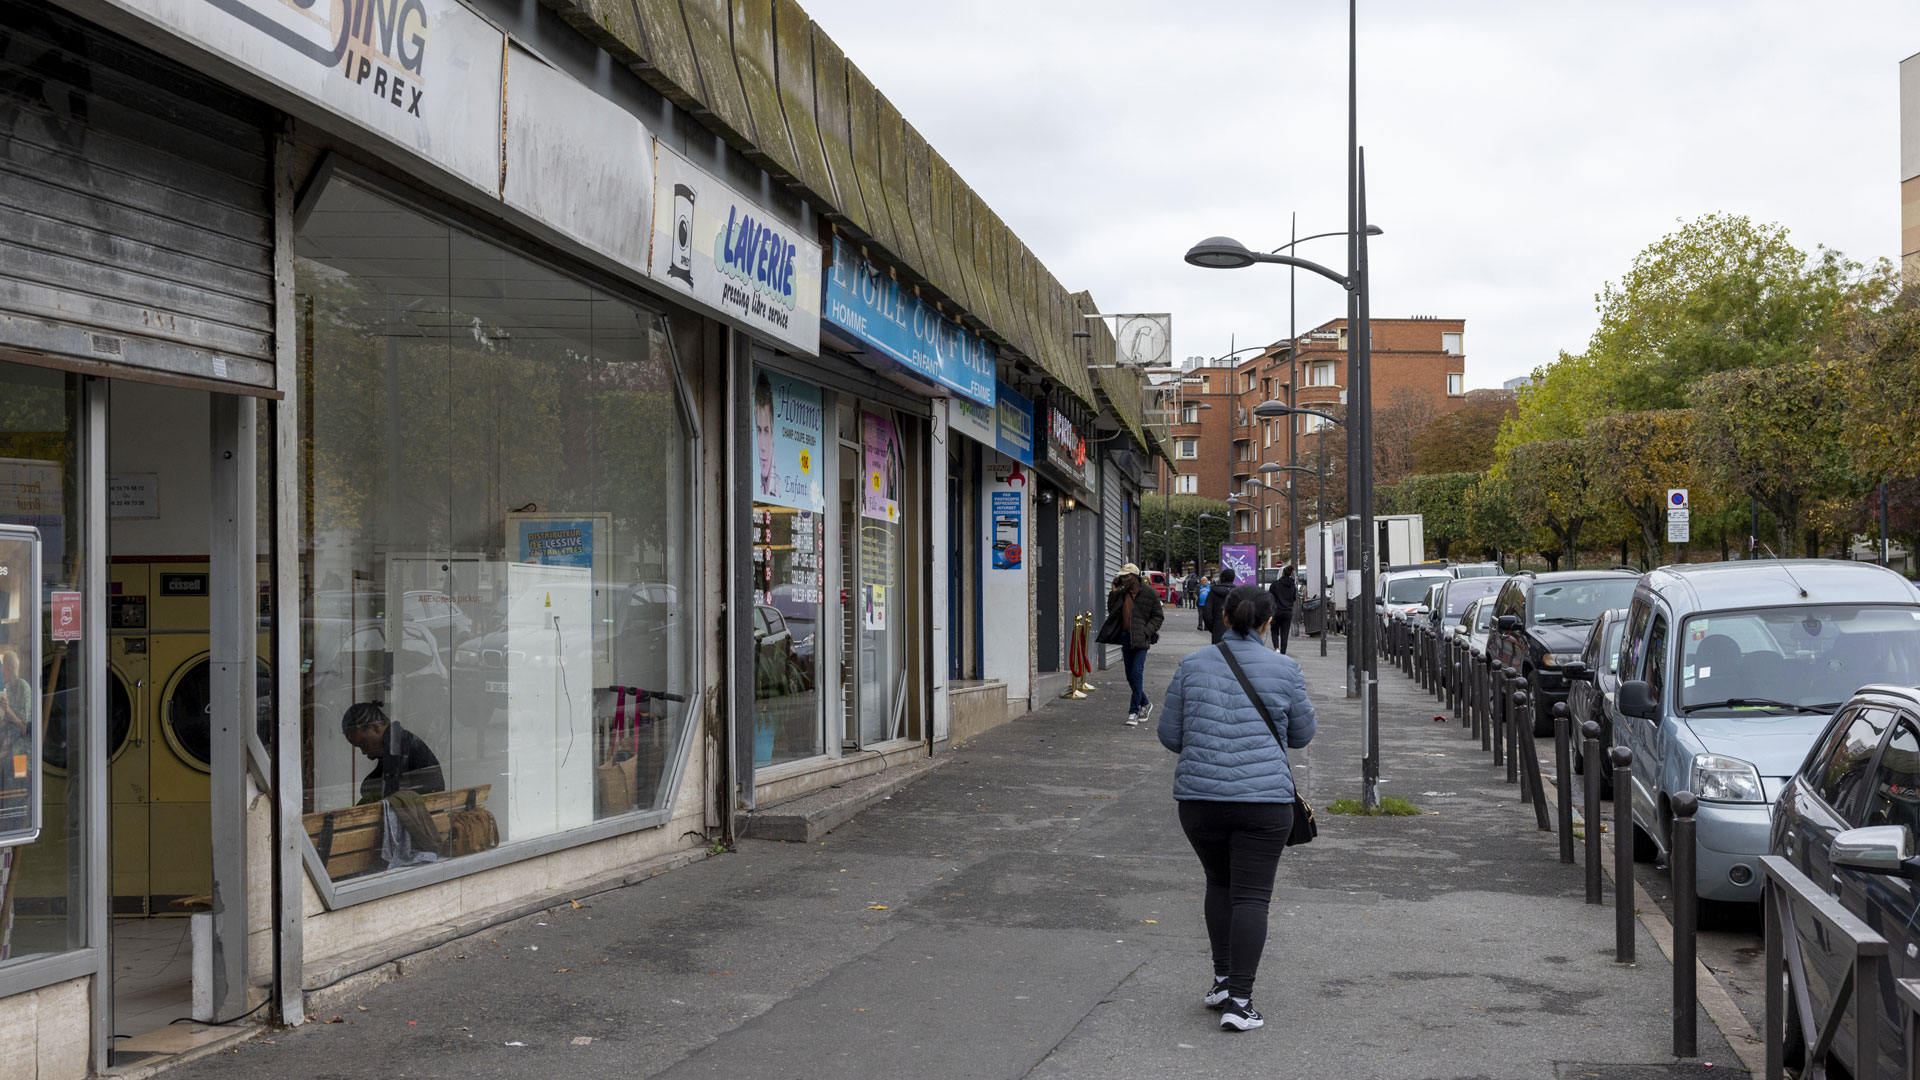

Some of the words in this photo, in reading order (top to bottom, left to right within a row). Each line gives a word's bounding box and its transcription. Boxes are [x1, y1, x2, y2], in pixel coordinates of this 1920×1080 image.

[345, 50, 423, 118] IPREX
[724, 204, 796, 296] LAVERIE
[721, 282, 750, 317] pressing
[751, 292, 767, 318] libre
[768, 305, 789, 330] service
[832, 299, 867, 337] HOMME
[913, 304, 991, 377] COFFURE
[912, 349, 939, 376] ENFANT
[970, 381, 991, 402] FEMME
[777, 382, 821, 432] Homme
[785, 475, 807, 502] Enfant
[528, 529, 581, 540] DISTRIBUTEUR
[530, 540, 542, 550] DE
[545, 537, 582, 549] LESSIVE
[529, 550, 541, 558] EN
[543, 546, 583, 557] TABLETTES
[169, 578, 200, 590] cissell
[418, 594, 456, 603] AliExpress
[458, 594, 482, 604] pickup
[54, 629, 80, 638] AliExpress
